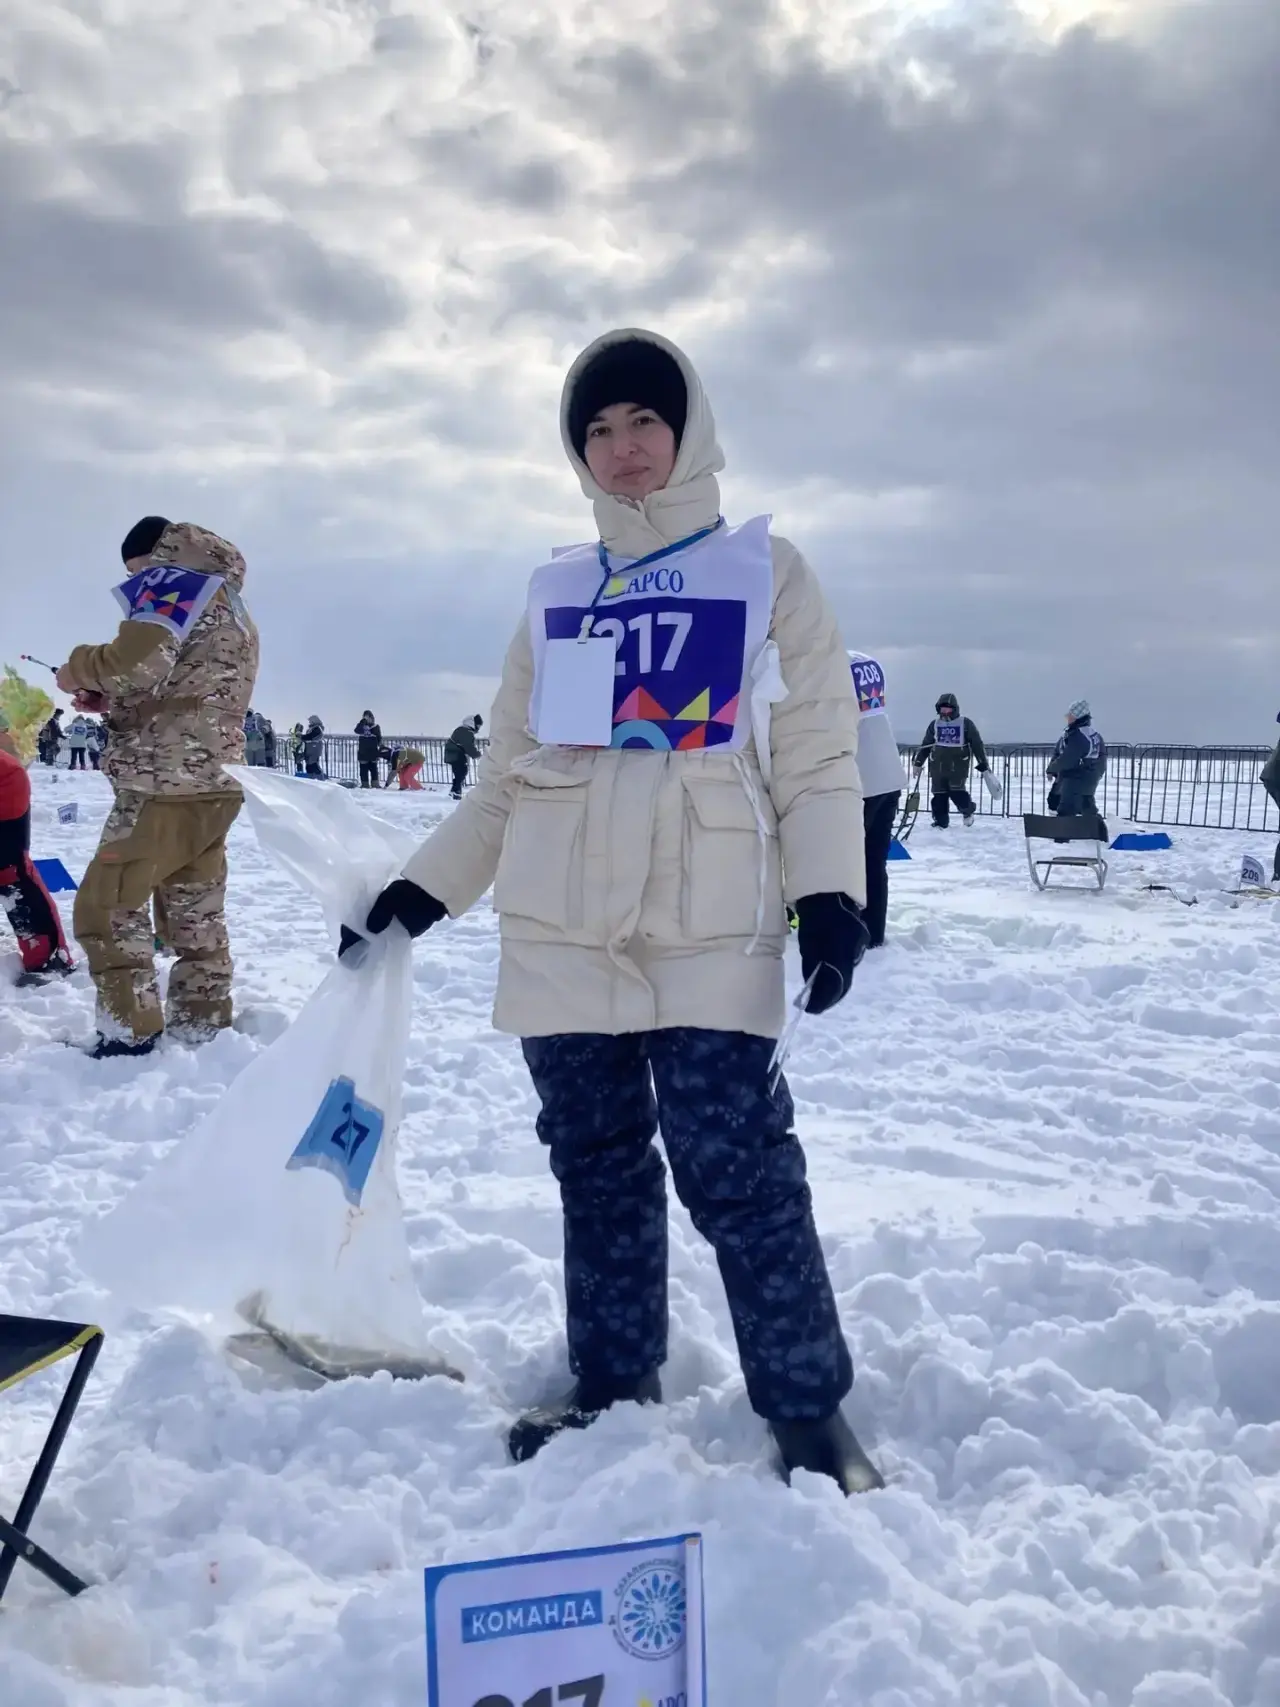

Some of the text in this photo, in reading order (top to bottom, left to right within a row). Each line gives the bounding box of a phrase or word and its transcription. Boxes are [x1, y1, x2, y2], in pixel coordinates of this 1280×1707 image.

[854, 664, 881, 686] 208
[1241, 868, 1260, 882] 209
[472, 1599, 597, 1636] КОМАНДА
